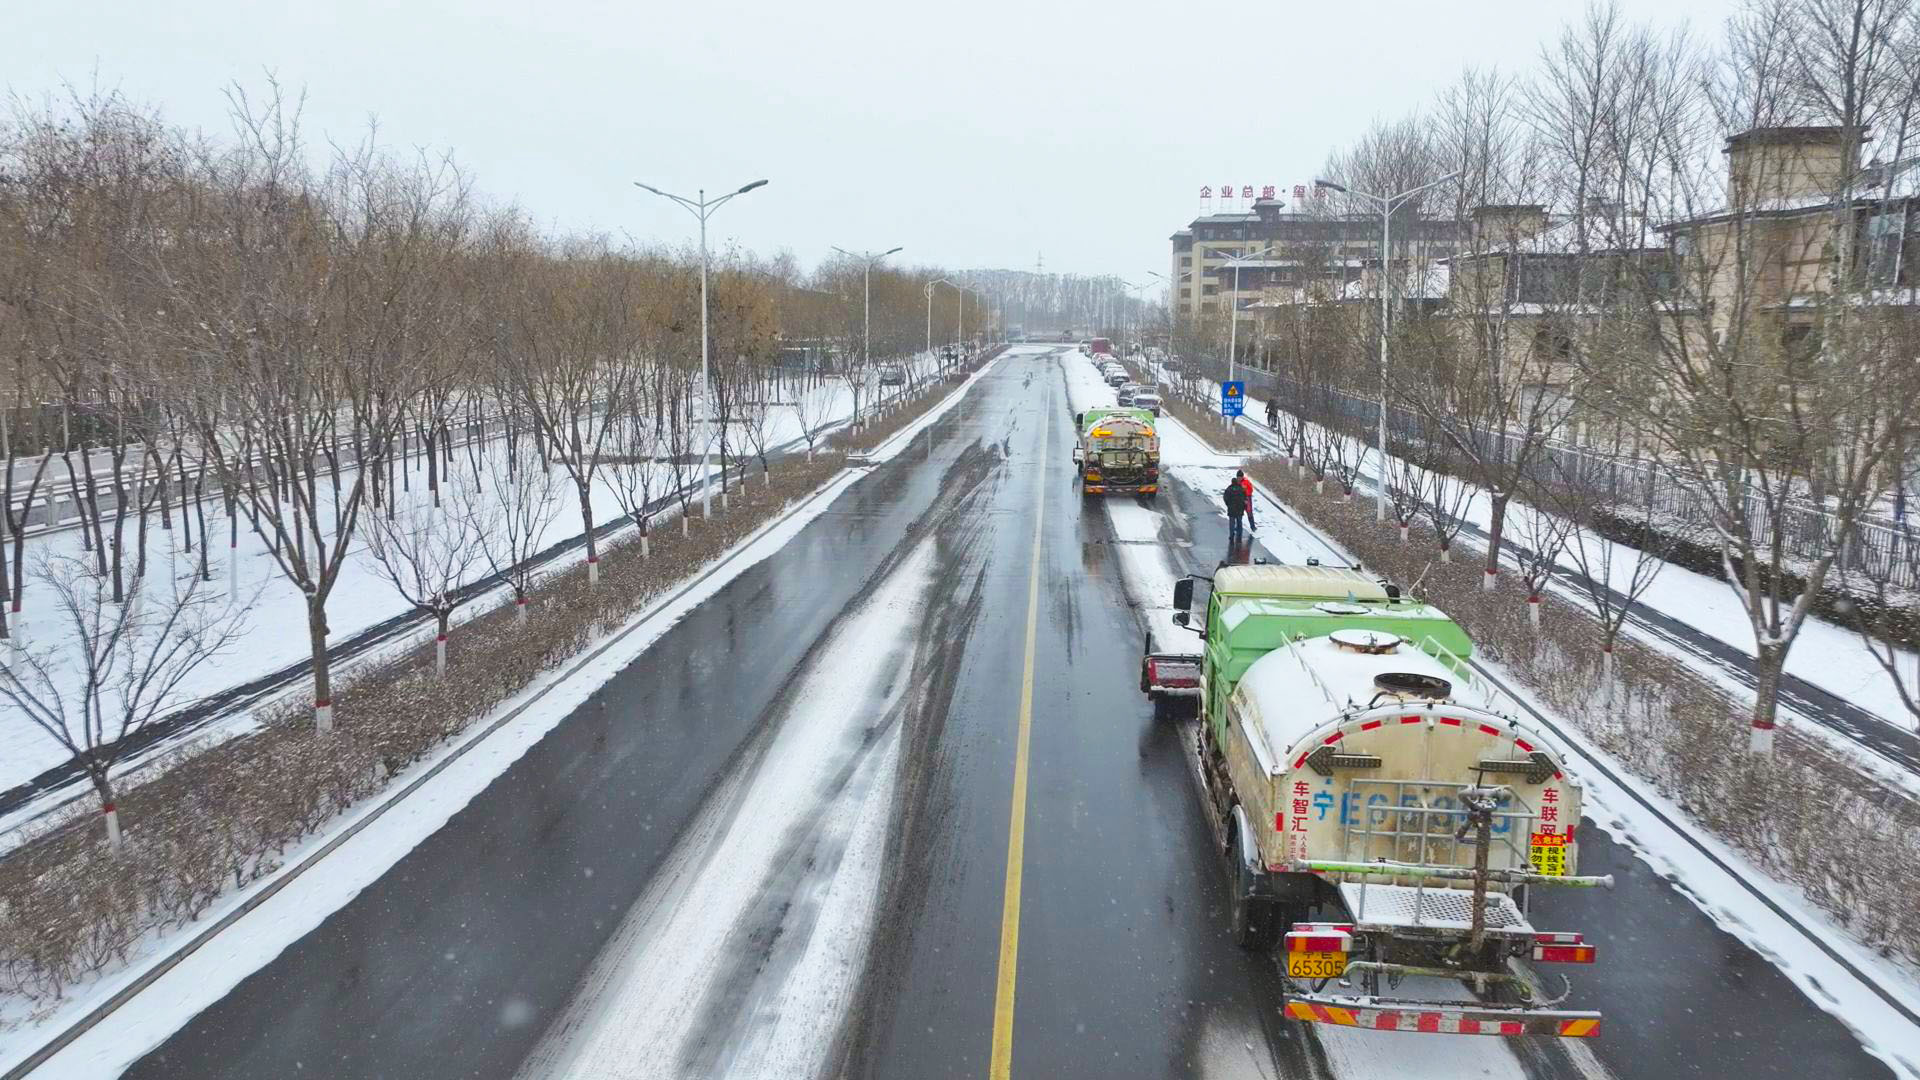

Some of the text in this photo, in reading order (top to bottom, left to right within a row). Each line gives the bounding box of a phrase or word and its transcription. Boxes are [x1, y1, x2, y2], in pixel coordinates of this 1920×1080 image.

[1291, 780, 1310, 832] 车智汇
[1541, 787, 1559, 834] 车联网
[1292, 960, 1344, 976] 65305
